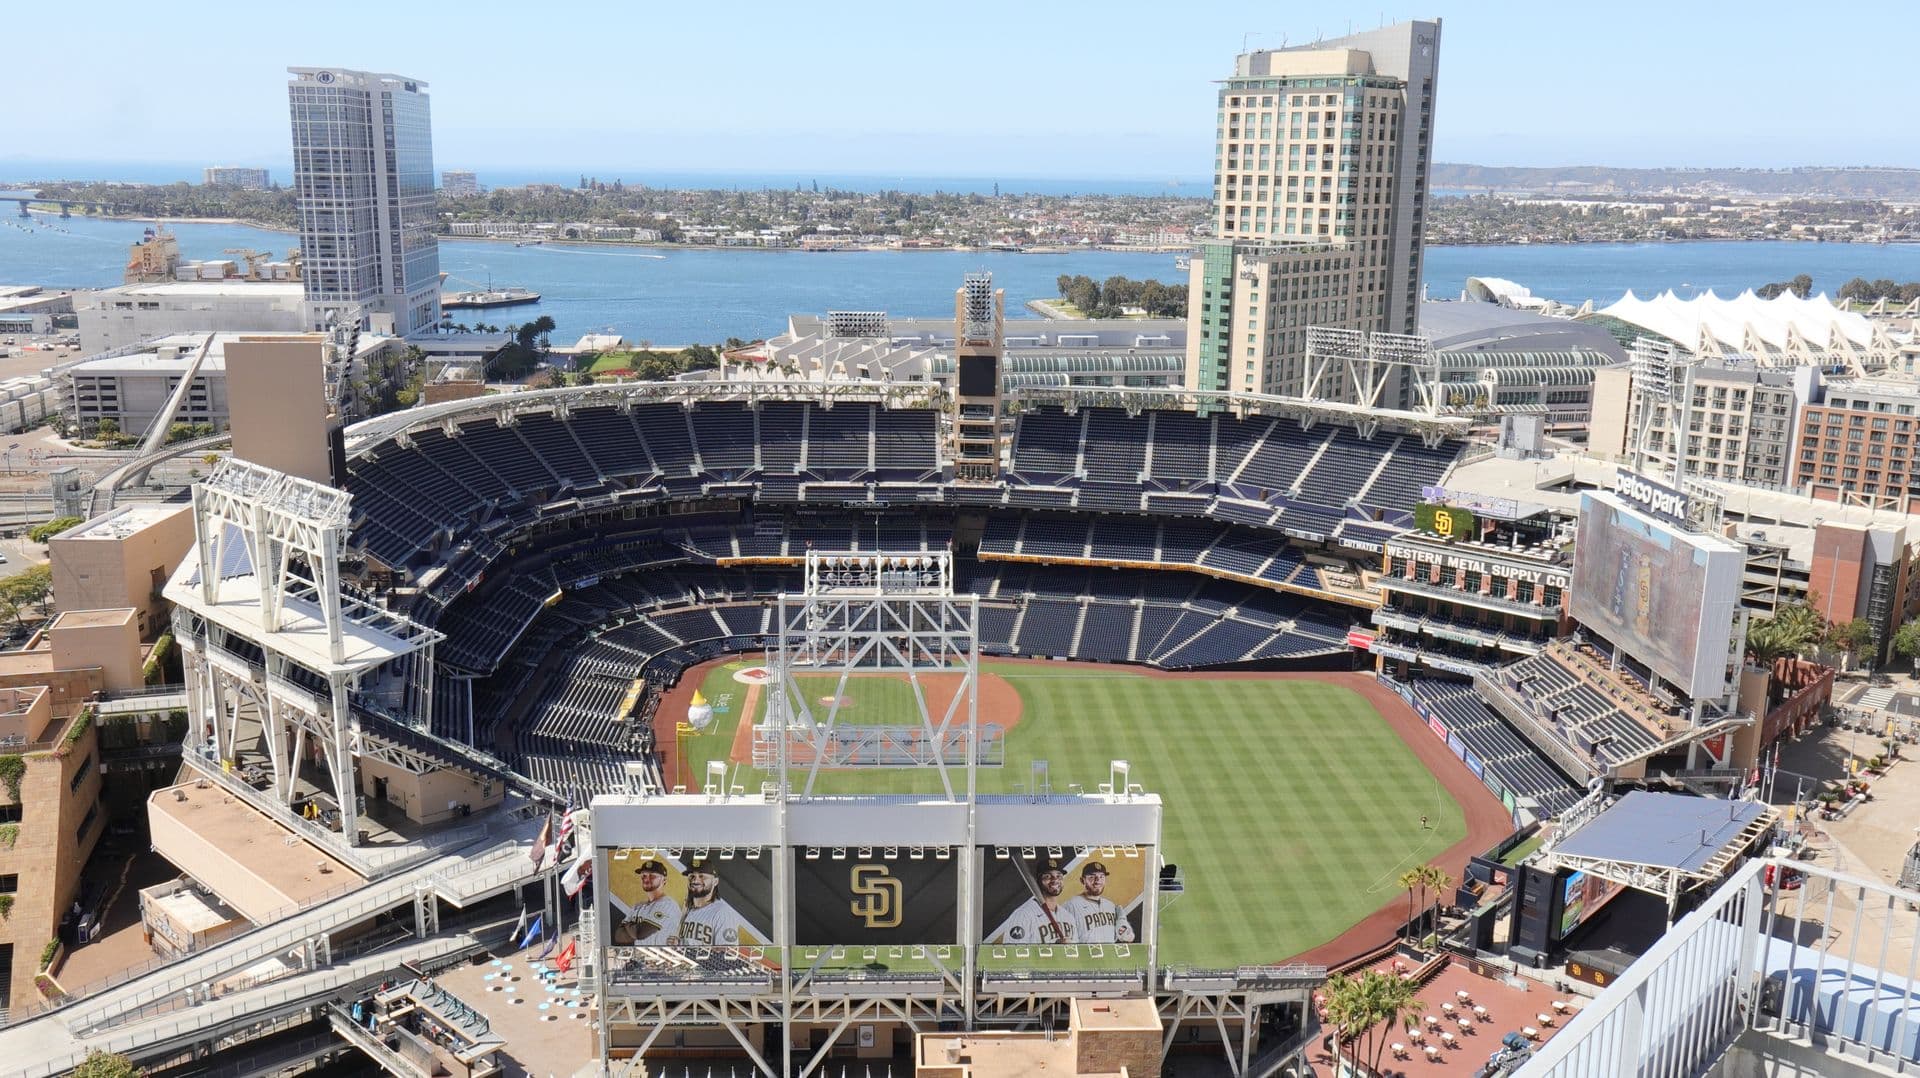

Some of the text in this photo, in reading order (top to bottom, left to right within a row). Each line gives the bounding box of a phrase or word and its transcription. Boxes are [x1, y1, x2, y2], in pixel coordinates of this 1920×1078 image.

[1615, 473, 1686, 519] petco park
[1434, 510, 1452, 535] SD
[1387, 545, 1569, 590] WESTERN METAL SUPPLY CO.
[850, 864, 903, 928] SD
